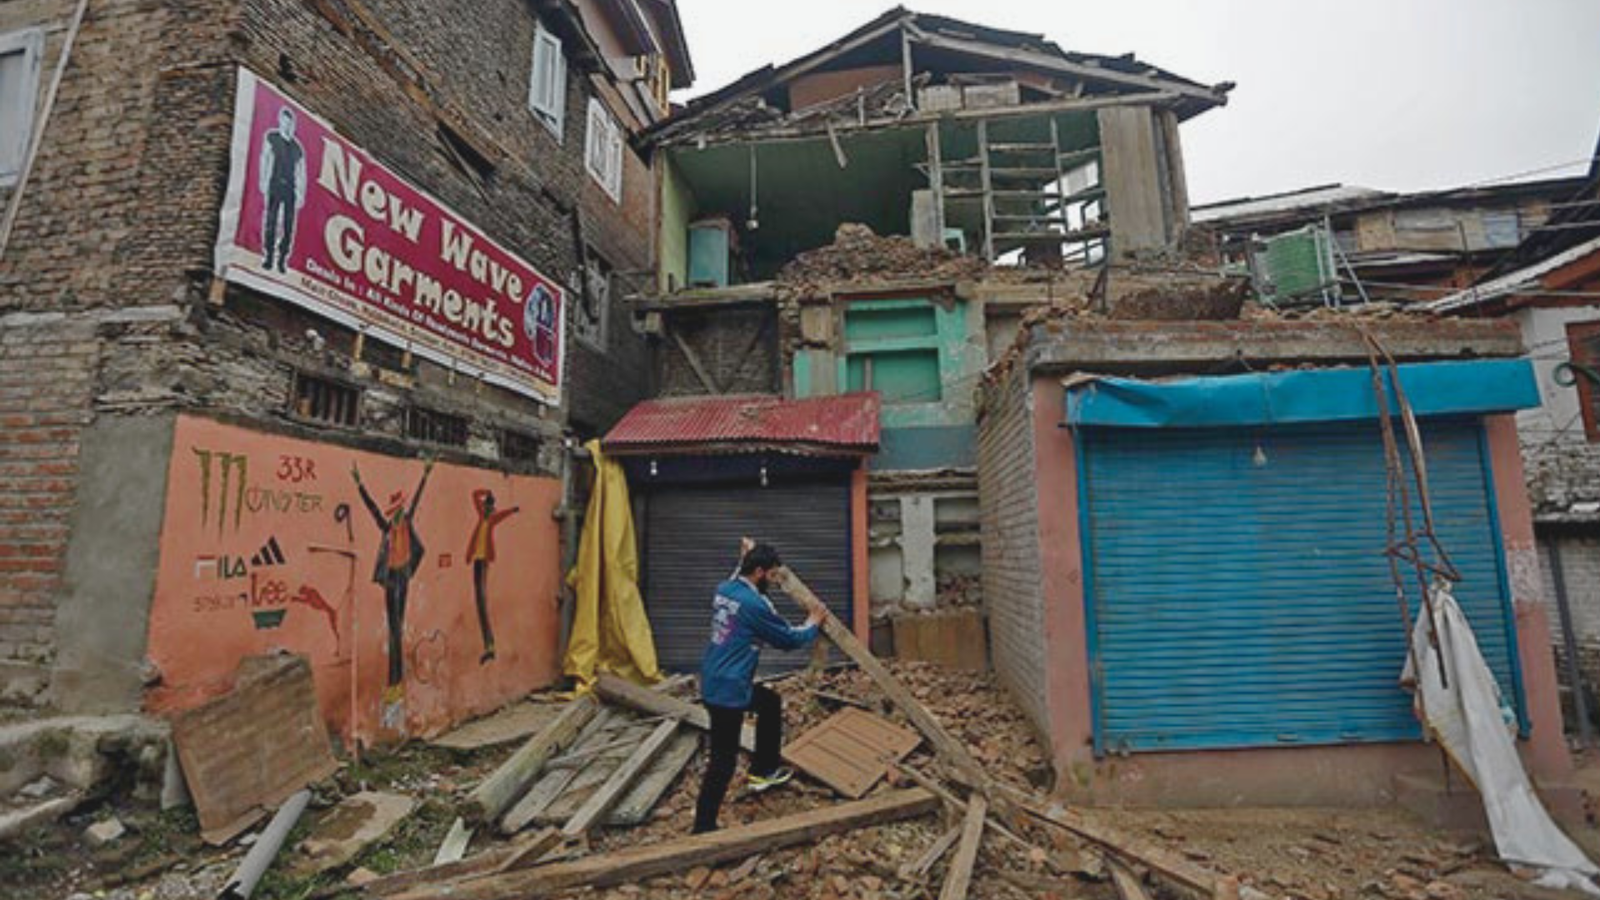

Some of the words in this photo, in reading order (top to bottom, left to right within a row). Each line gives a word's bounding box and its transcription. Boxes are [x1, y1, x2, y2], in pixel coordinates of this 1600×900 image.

[318, 136, 424, 243] New
[441, 218, 522, 303] Wave
[325, 214, 514, 347] Garments
[194, 555, 247, 579] FILA
[252, 572, 287, 606] Lee
